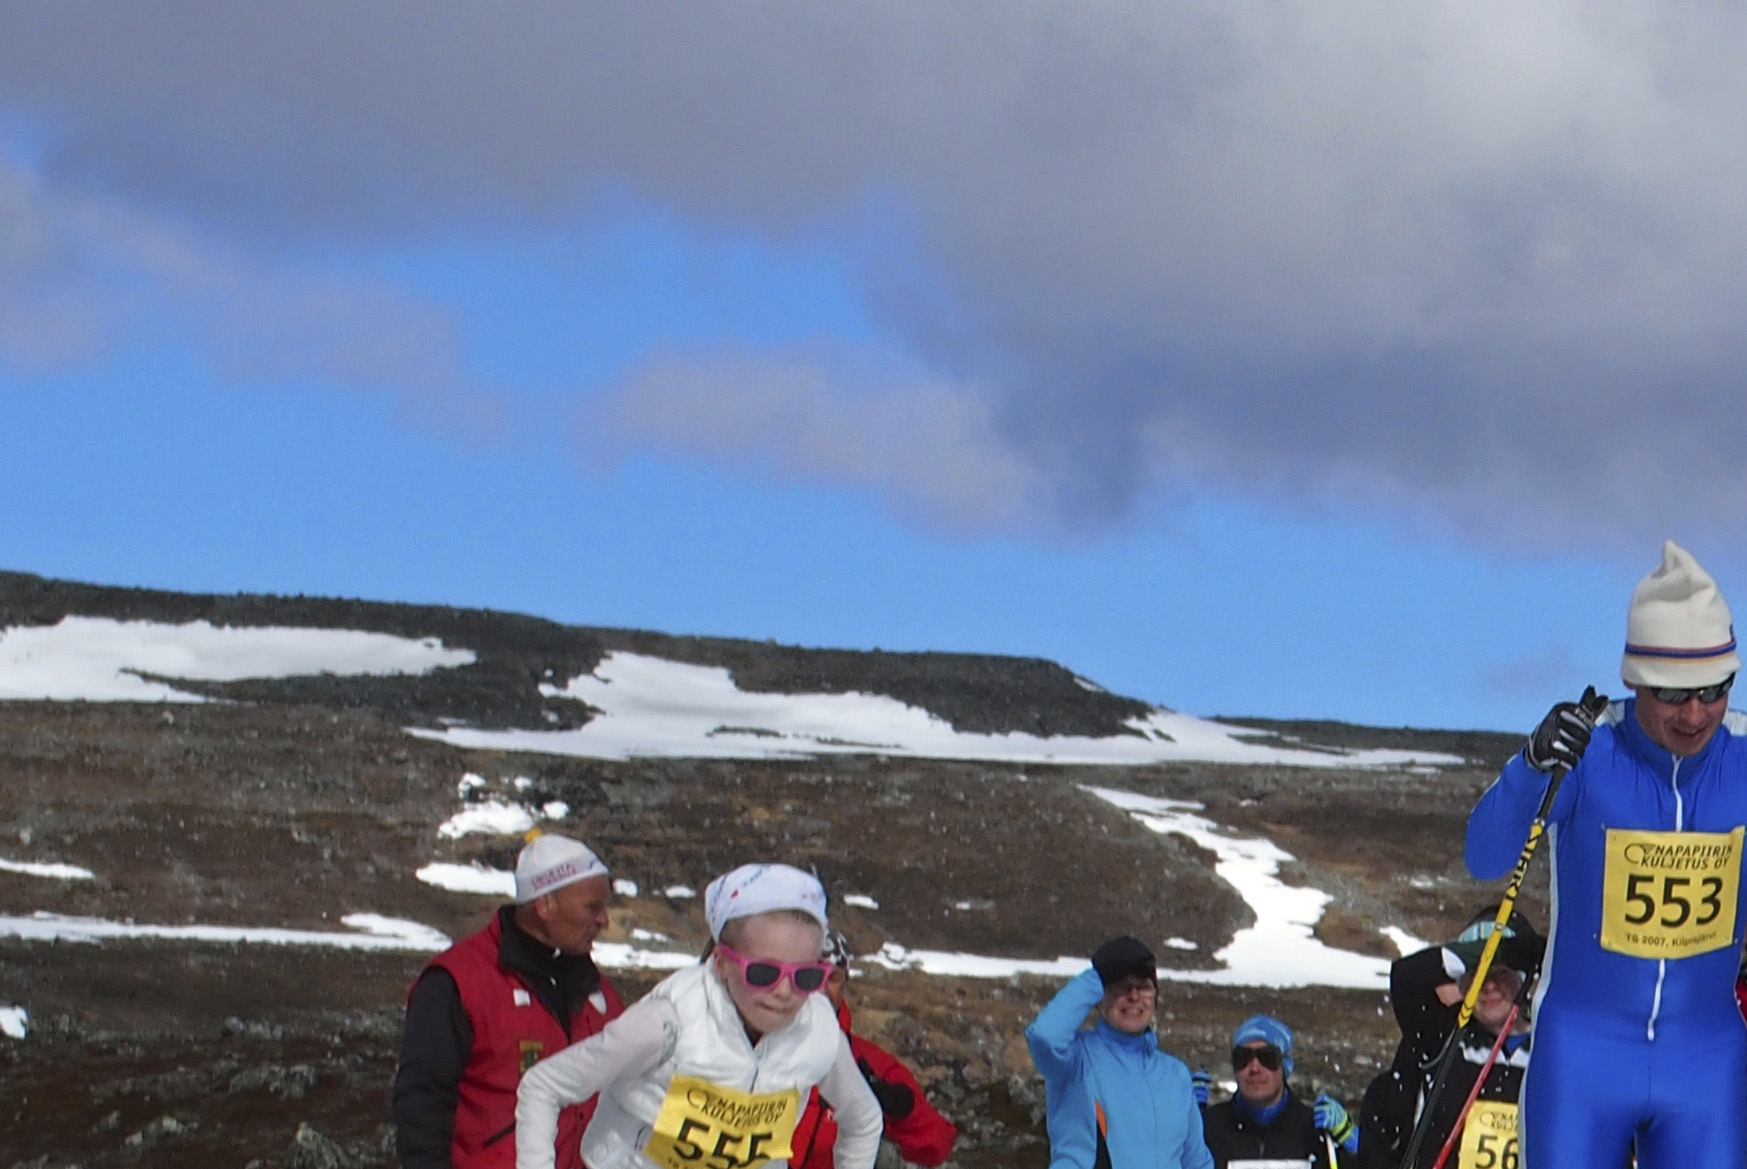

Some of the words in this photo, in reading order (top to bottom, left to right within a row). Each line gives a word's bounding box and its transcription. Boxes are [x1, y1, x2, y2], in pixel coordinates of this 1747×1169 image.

[1655, 844, 1733, 857] NAPAPIIRIN
[1641, 856, 1708, 869] KULJETUS
[1714, 857, 1729, 870] OY
[1624, 874, 1723, 928] 553
